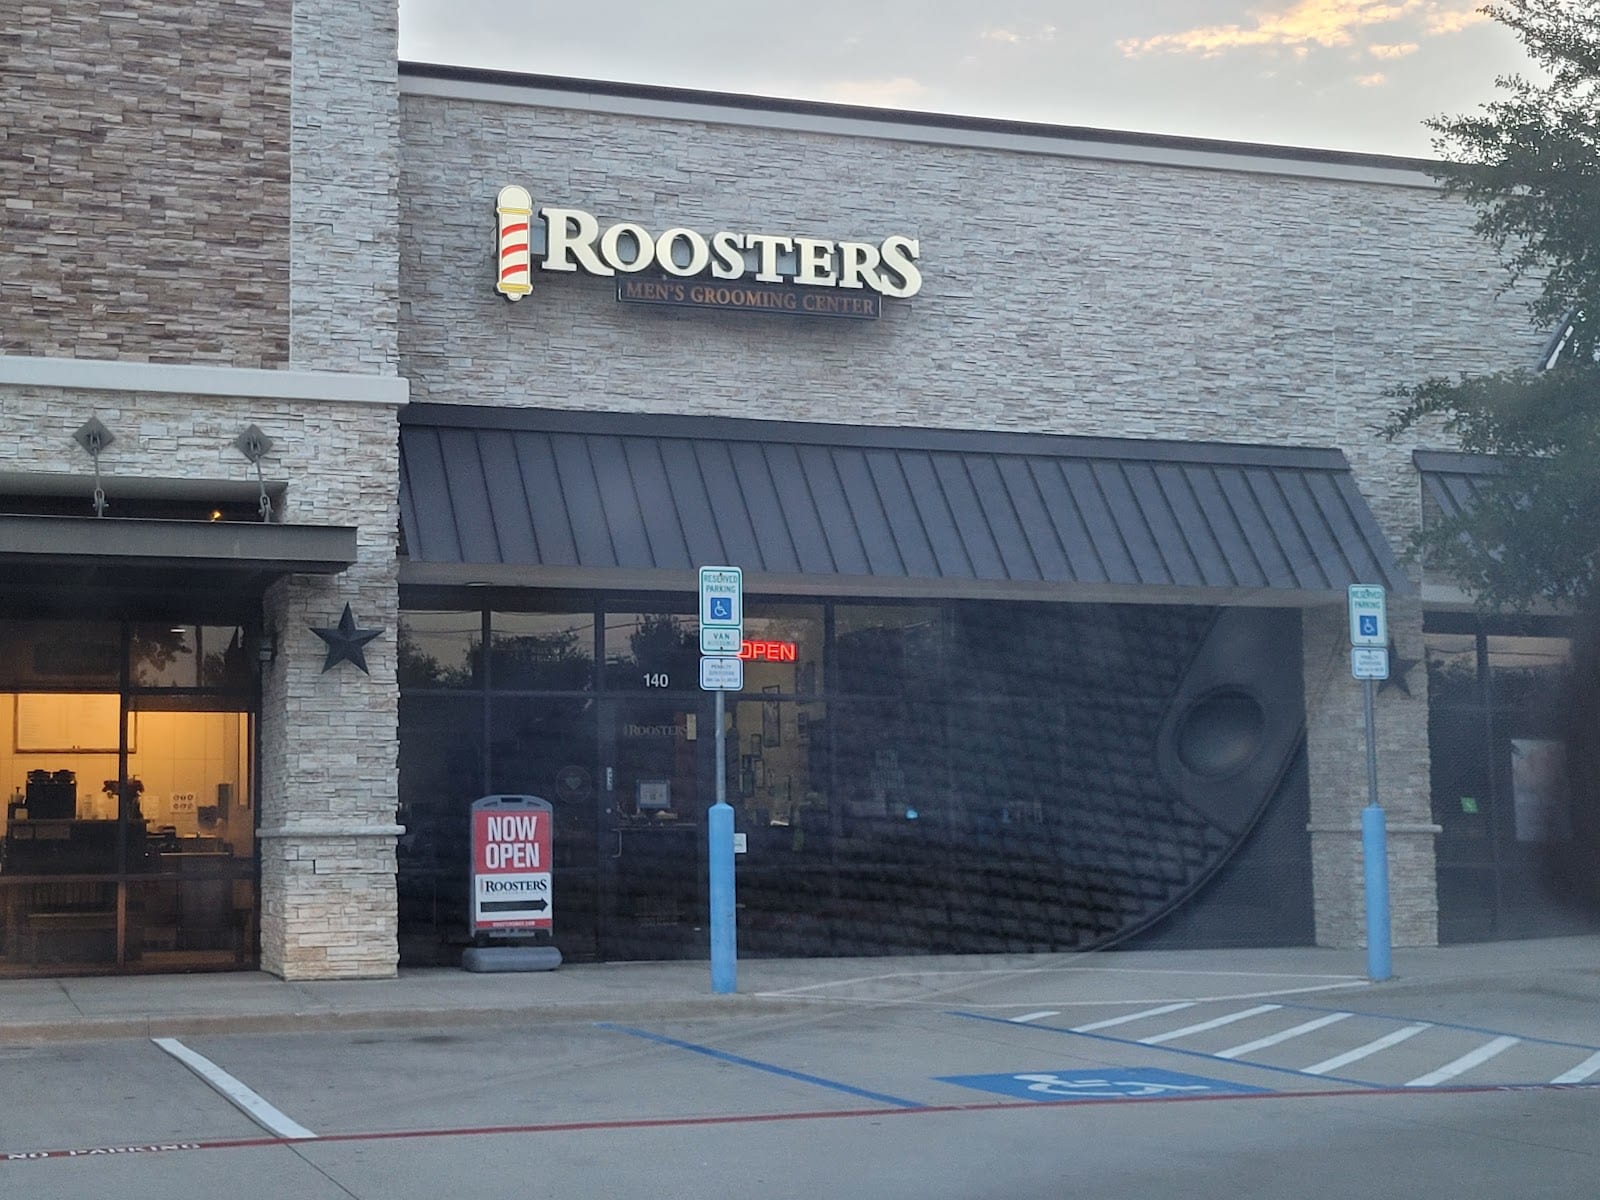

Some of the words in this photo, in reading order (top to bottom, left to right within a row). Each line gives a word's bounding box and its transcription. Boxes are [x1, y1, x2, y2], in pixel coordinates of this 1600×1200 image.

[541, 207, 922, 298] ROOSTERS
[626, 282, 685, 301] MEN'S
[690, 287, 797, 309] GROOMING
[802, 294, 874, 314] CENTER
[703, 574, 738, 584] RESERVED
[705, 585, 737, 594] PARKING
[713, 632, 730, 640] VAN
[740, 640, 796, 661] OPEN
[643, 673, 669, 688] 140
[487, 815, 538, 842] NOW
[485, 842, 540, 869] OPEN
[485, 879, 548, 893] ROOSTERS
[8, 1152, 50, 1160] NO
